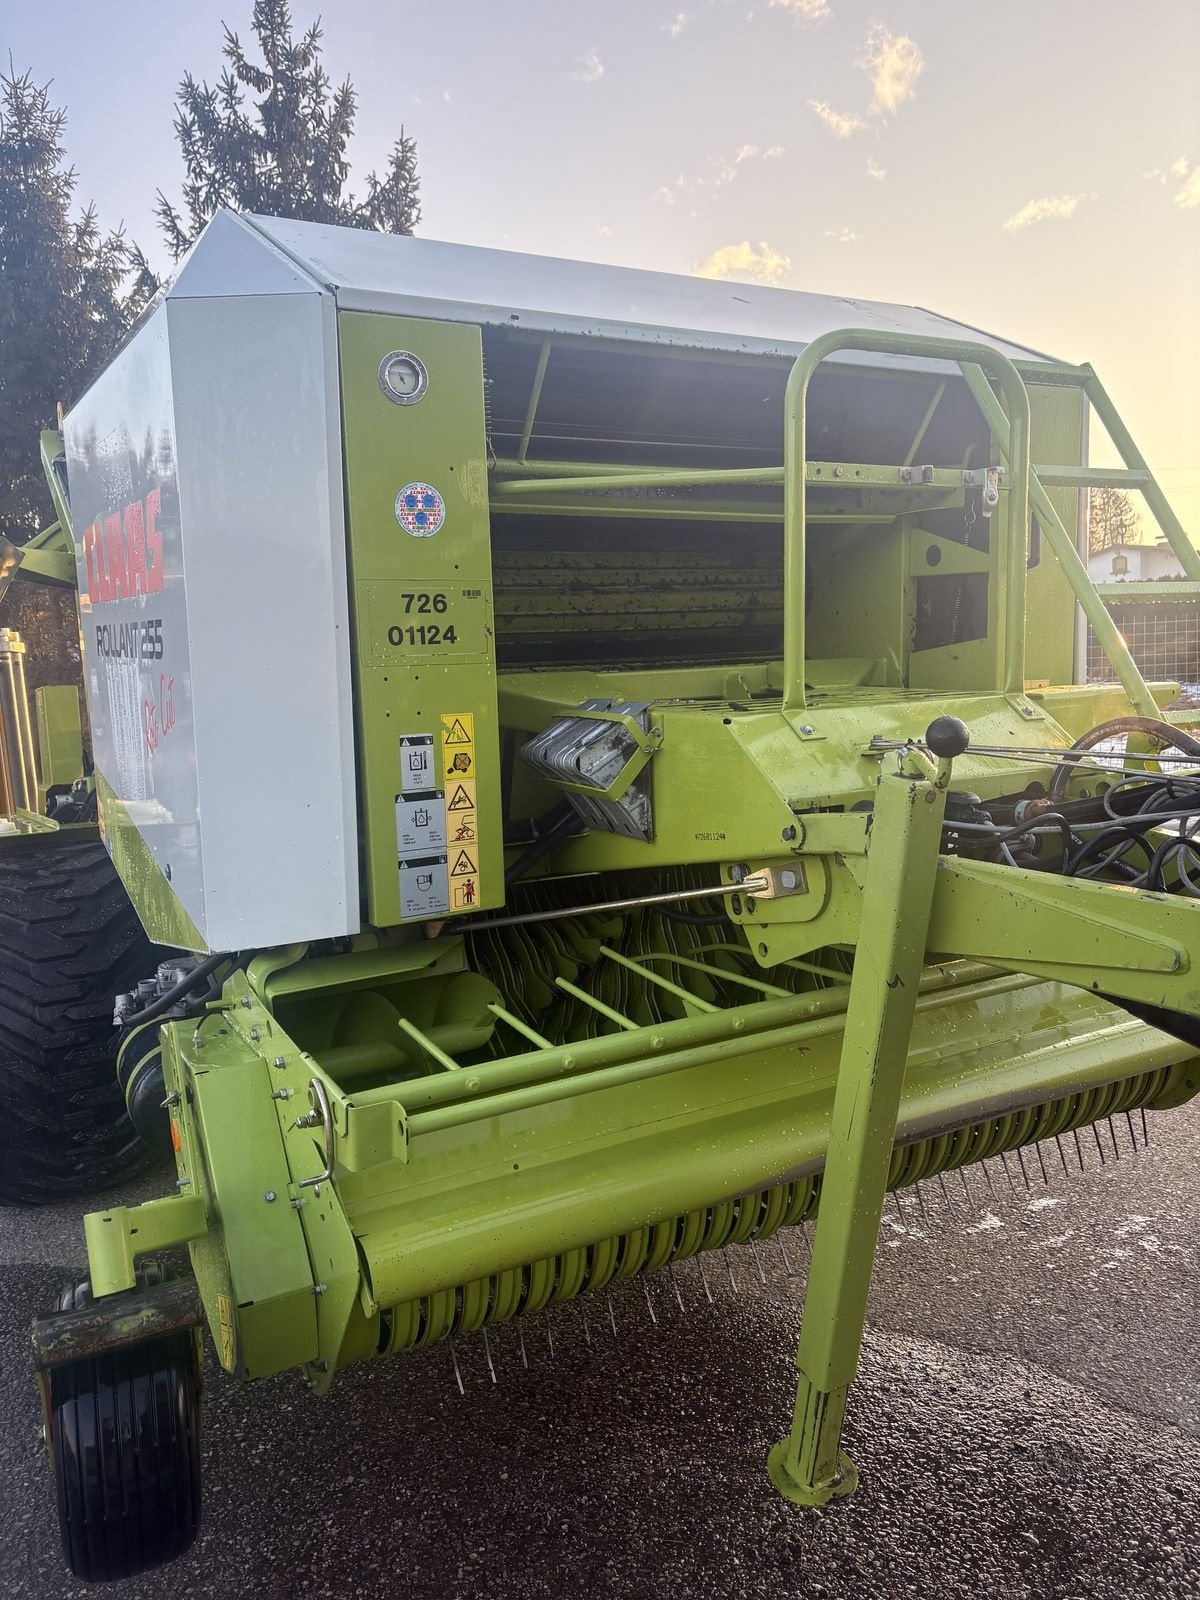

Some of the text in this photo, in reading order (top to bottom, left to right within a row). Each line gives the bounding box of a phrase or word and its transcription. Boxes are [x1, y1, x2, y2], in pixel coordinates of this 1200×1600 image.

[83, 486, 164, 604] CLAAS
[401, 593, 447, 614] 726
[96, 618, 164, 660] ROLLANT 255
[388, 625, 457, 646] 01124
